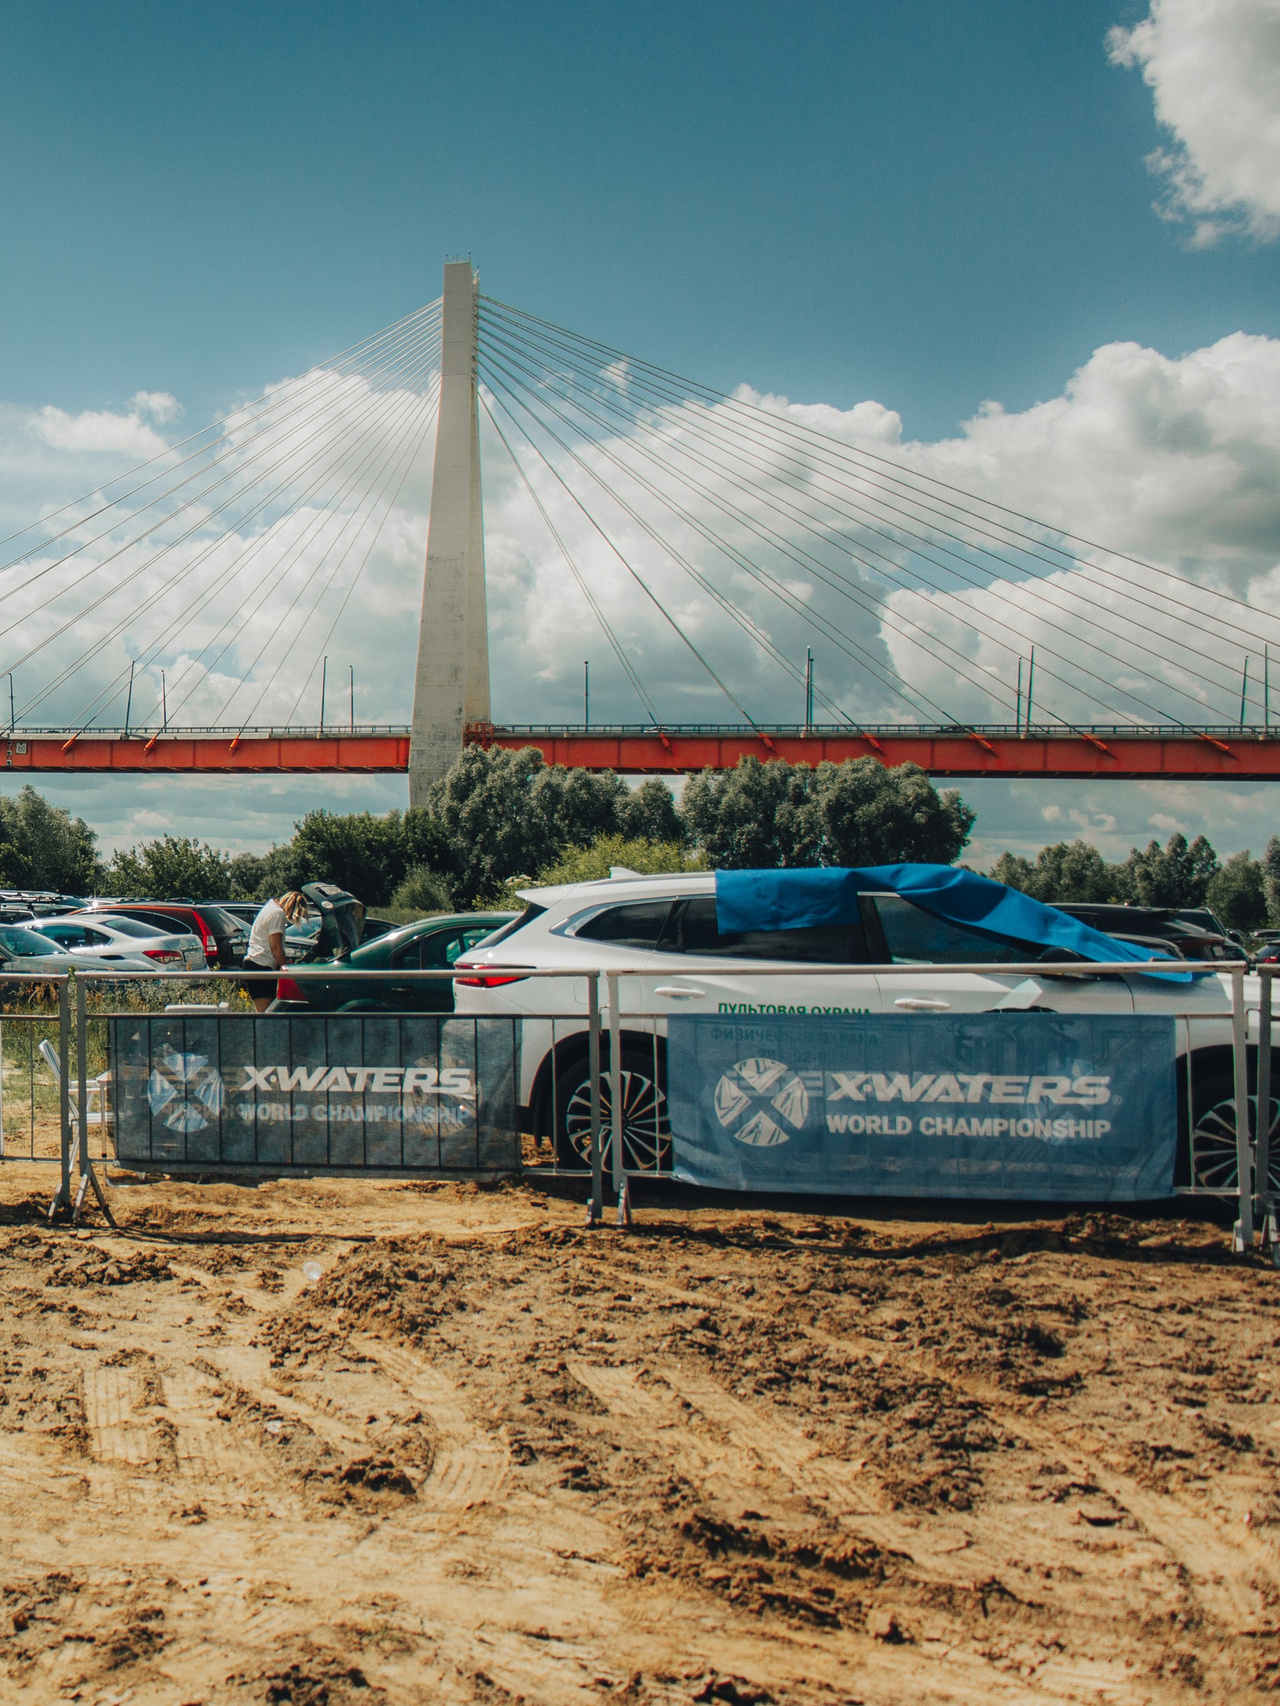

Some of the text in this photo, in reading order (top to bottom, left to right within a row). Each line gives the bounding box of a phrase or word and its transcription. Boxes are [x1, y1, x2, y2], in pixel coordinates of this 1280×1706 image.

[239, 1103, 470, 1123] WORLD CHAMPIONSHIP
[826, 1115, 1111, 1139] WORLD CHAMPIONSHIP
